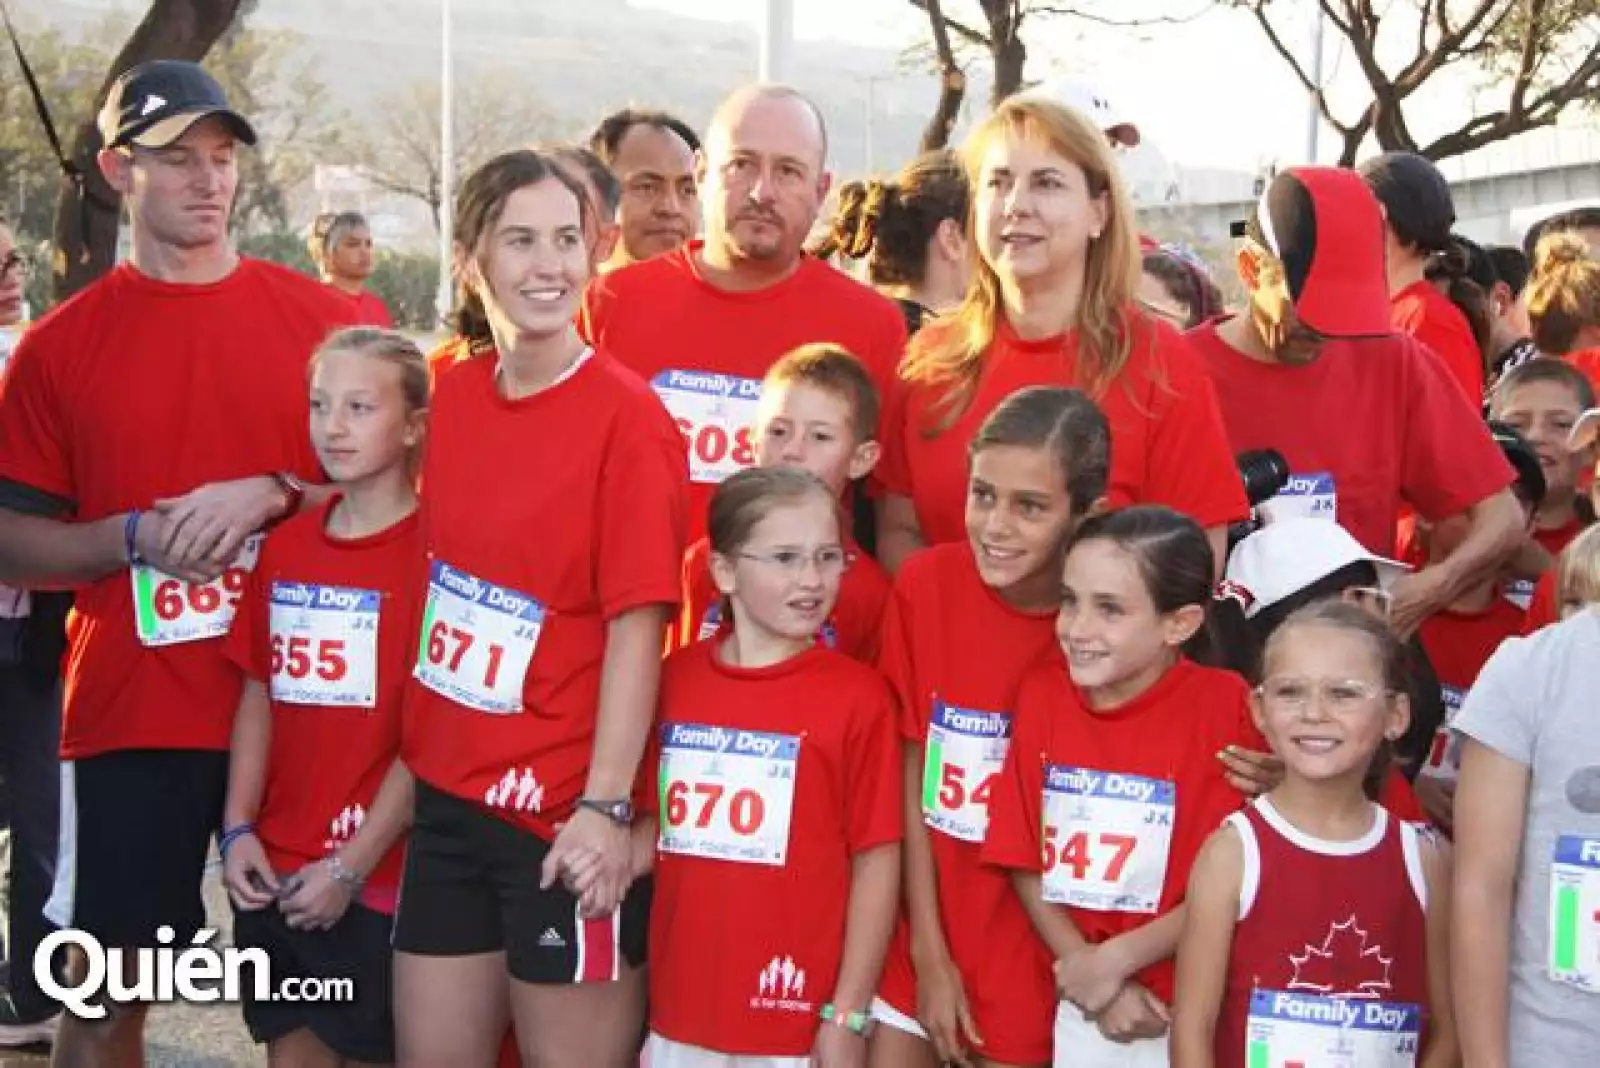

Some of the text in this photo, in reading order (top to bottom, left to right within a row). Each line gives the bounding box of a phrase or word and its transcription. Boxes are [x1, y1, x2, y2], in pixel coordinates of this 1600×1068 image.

[670, 369, 737, 397] Family
[677, 420, 757, 464] 08
[155, 568, 244, 620] 669
[271, 583, 361, 610] amily Day
[439, 564, 530, 619] Family Day
[427, 618, 506, 689] 671
[672, 724, 781, 757] Family Day
[667, 779, 766, 836] 670
[1103, 774, 1156, 802] Day
[1273, 994, 1408, 1031] Family Day
